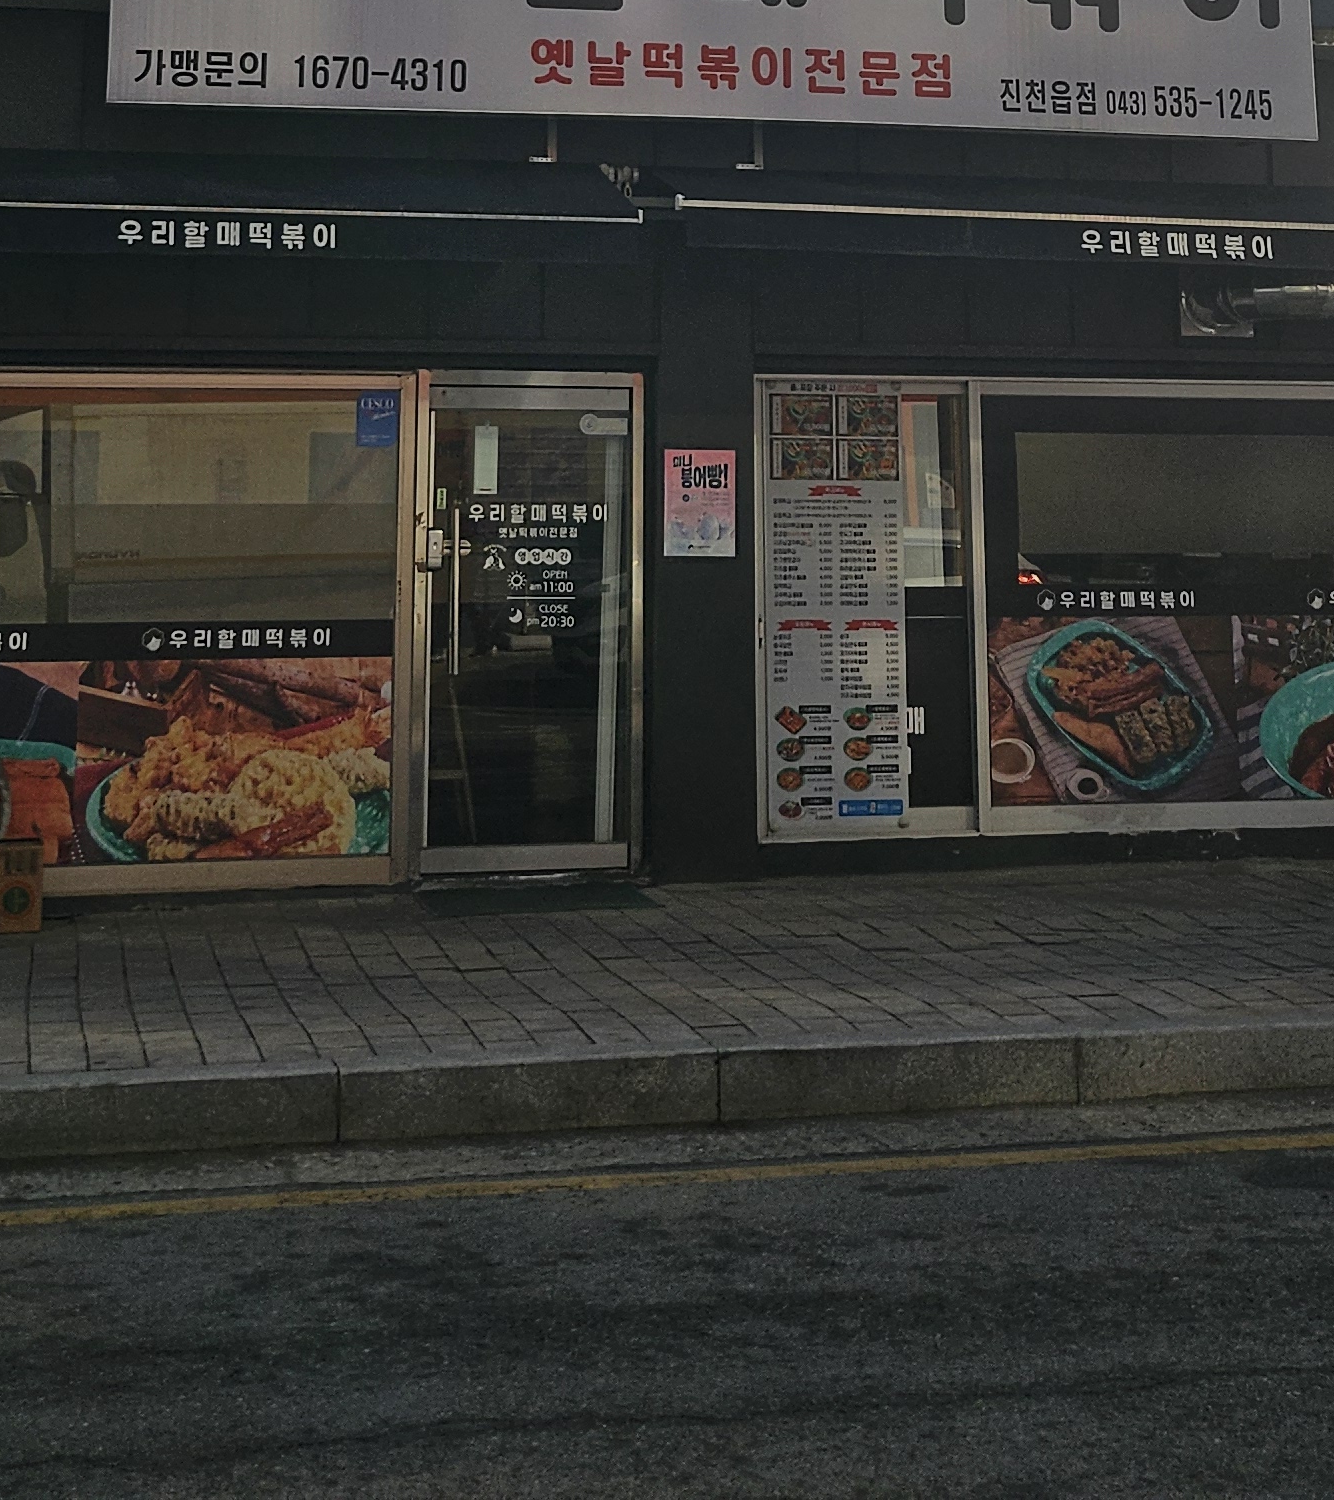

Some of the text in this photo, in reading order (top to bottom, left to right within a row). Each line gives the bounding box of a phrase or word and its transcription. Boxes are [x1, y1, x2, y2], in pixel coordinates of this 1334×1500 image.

[133, 47, 467, 93] 가맹문의 1670-4310
[529, 36, 955, 98] 옛날떡볶이전문점
[999, 77, 1098, 117] 진천읍점
[1154, 84, 1273, 122] 535-1245
[118, 221, 339, 252] 우리할매떡볶이
[1080, 227, 1275, 260] 우리할매떡볶이
[468, 503, 608, 523] 우리할매떡볶이
[498, 527, 578, 539] 옛날떡볶이전문점
[516, 549, 572, 565] 영업시간
[542, 570, 569, 583] OPEN
[538, 604, 569, 614] CLOSE
[1059, 590, 1196, 612] 우리할매떡볶이
[169, 626, 332, 649] 우리할매떡볶이
